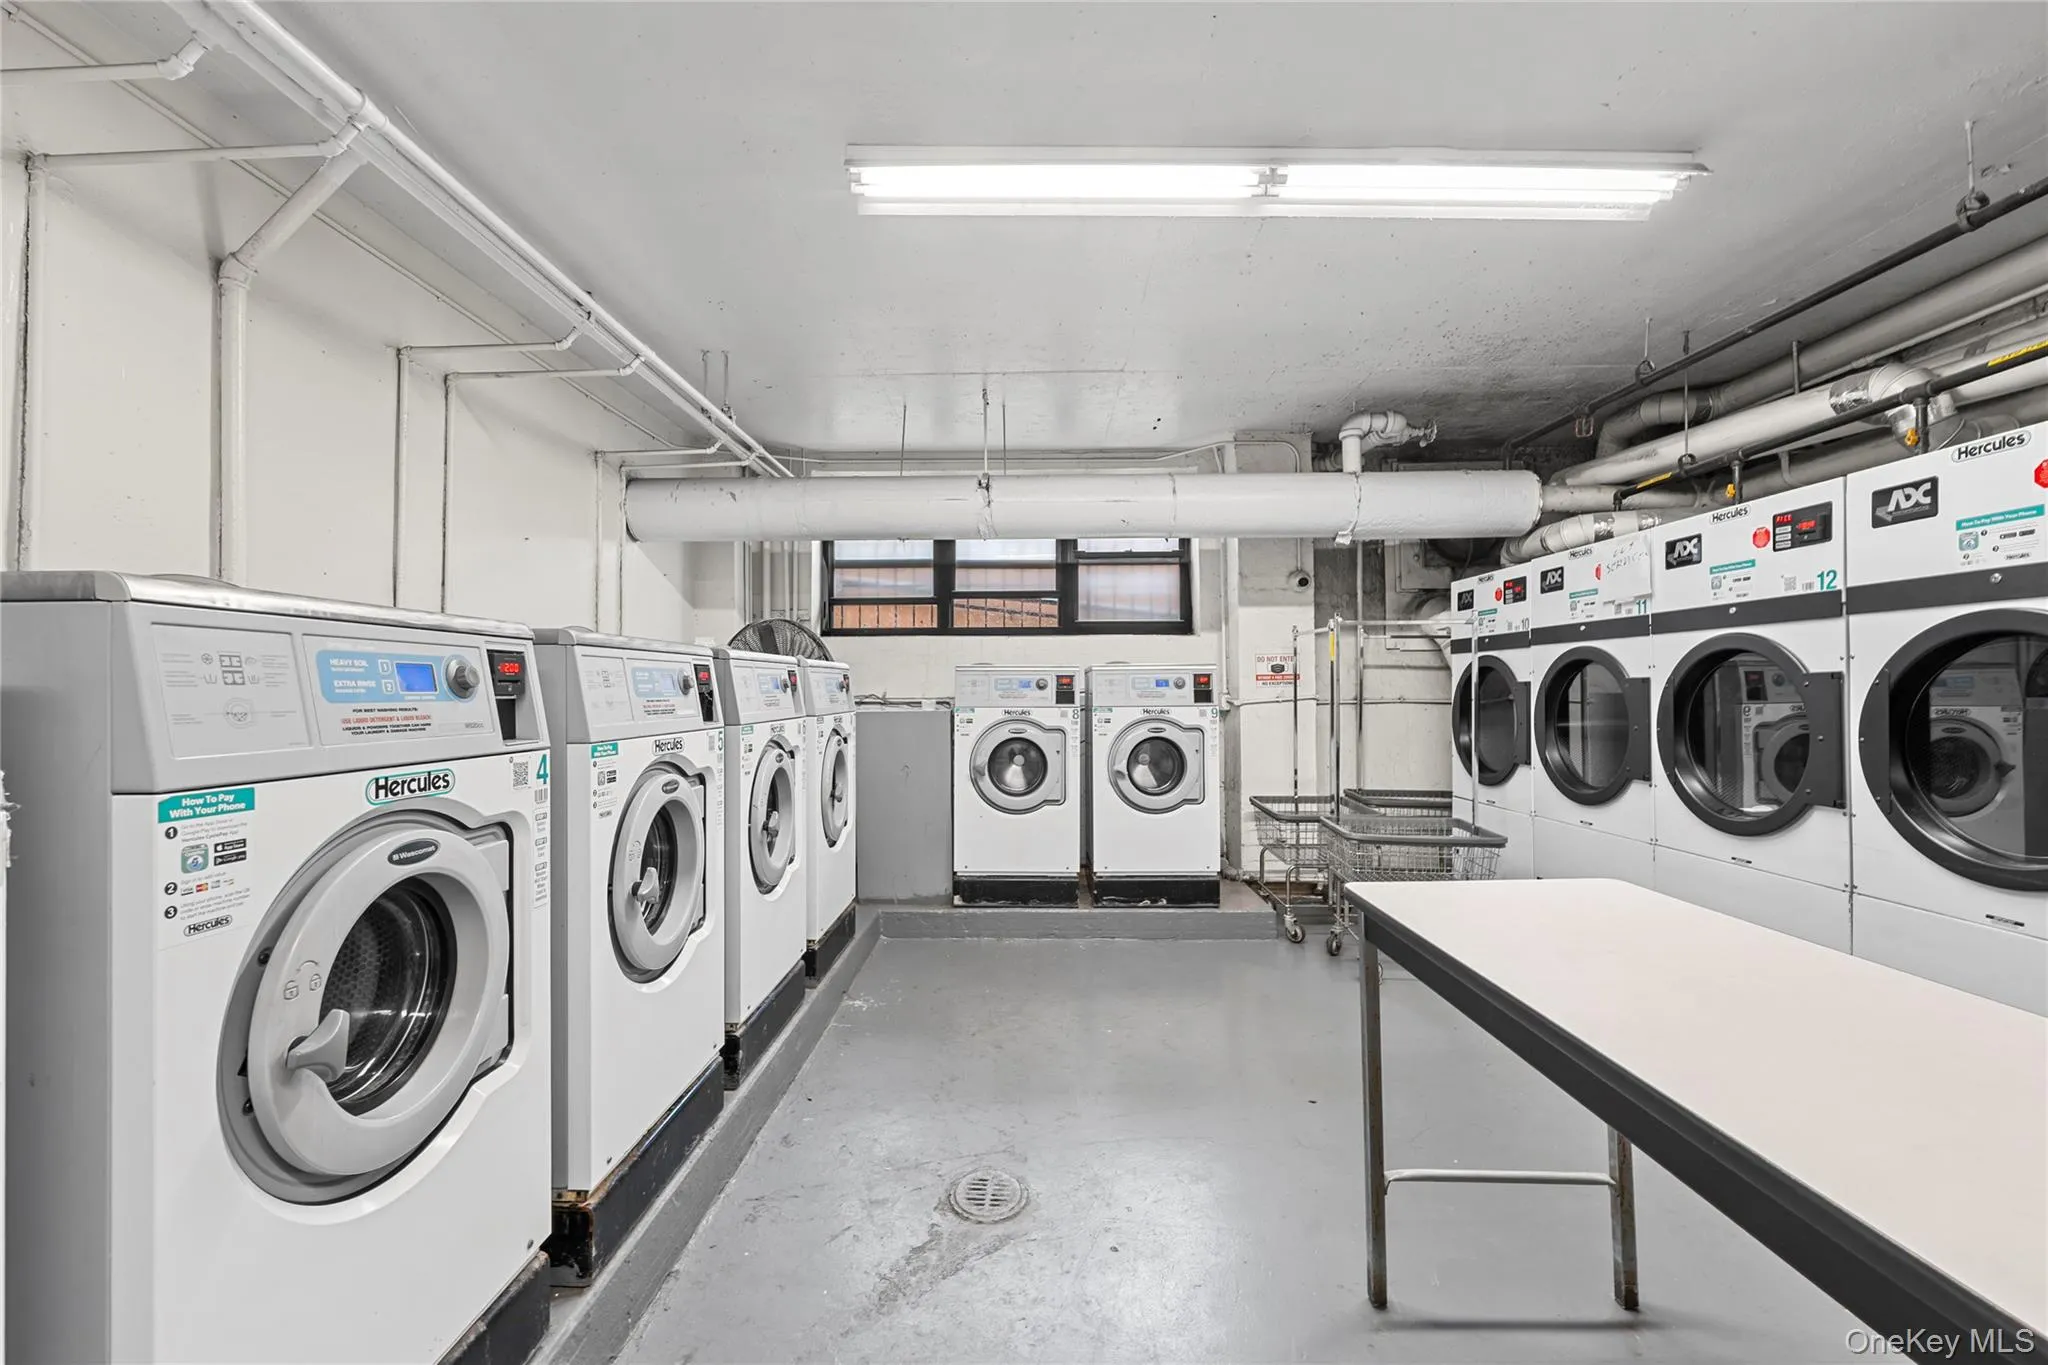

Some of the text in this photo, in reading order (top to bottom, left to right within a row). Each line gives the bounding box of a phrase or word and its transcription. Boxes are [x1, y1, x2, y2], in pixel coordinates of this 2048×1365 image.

[1958, 433, 2024, 460] Hercules
[1712, 507, 1747, 522] Hercules
[1817, 569, 1837, 591] 12
[1636, 600, 1647, 615] 11
[1522, 618, 1530, 631] 10
[330, 658, 368, 667] HEAVY SOIL
[334, 680, 357, 688] EXTRA
[1003, 708, 1031, 716] Hercules
[1072, 709, 1079, 720] 8
[1211, 707, 1218, 719] 9
[654, 737, 683, 753] Hercules
[718, 730, 723, 751] 5
[536, 754, 548, 784] 4
[374, 771, 450, 799] Hercules
[182, 793, 235, 807] How To Pay
[169, 802, 246, 818] With Your Phone
[399, 845, 436, 859] Wascomat
[188, 916, 230, 934] Hercules
